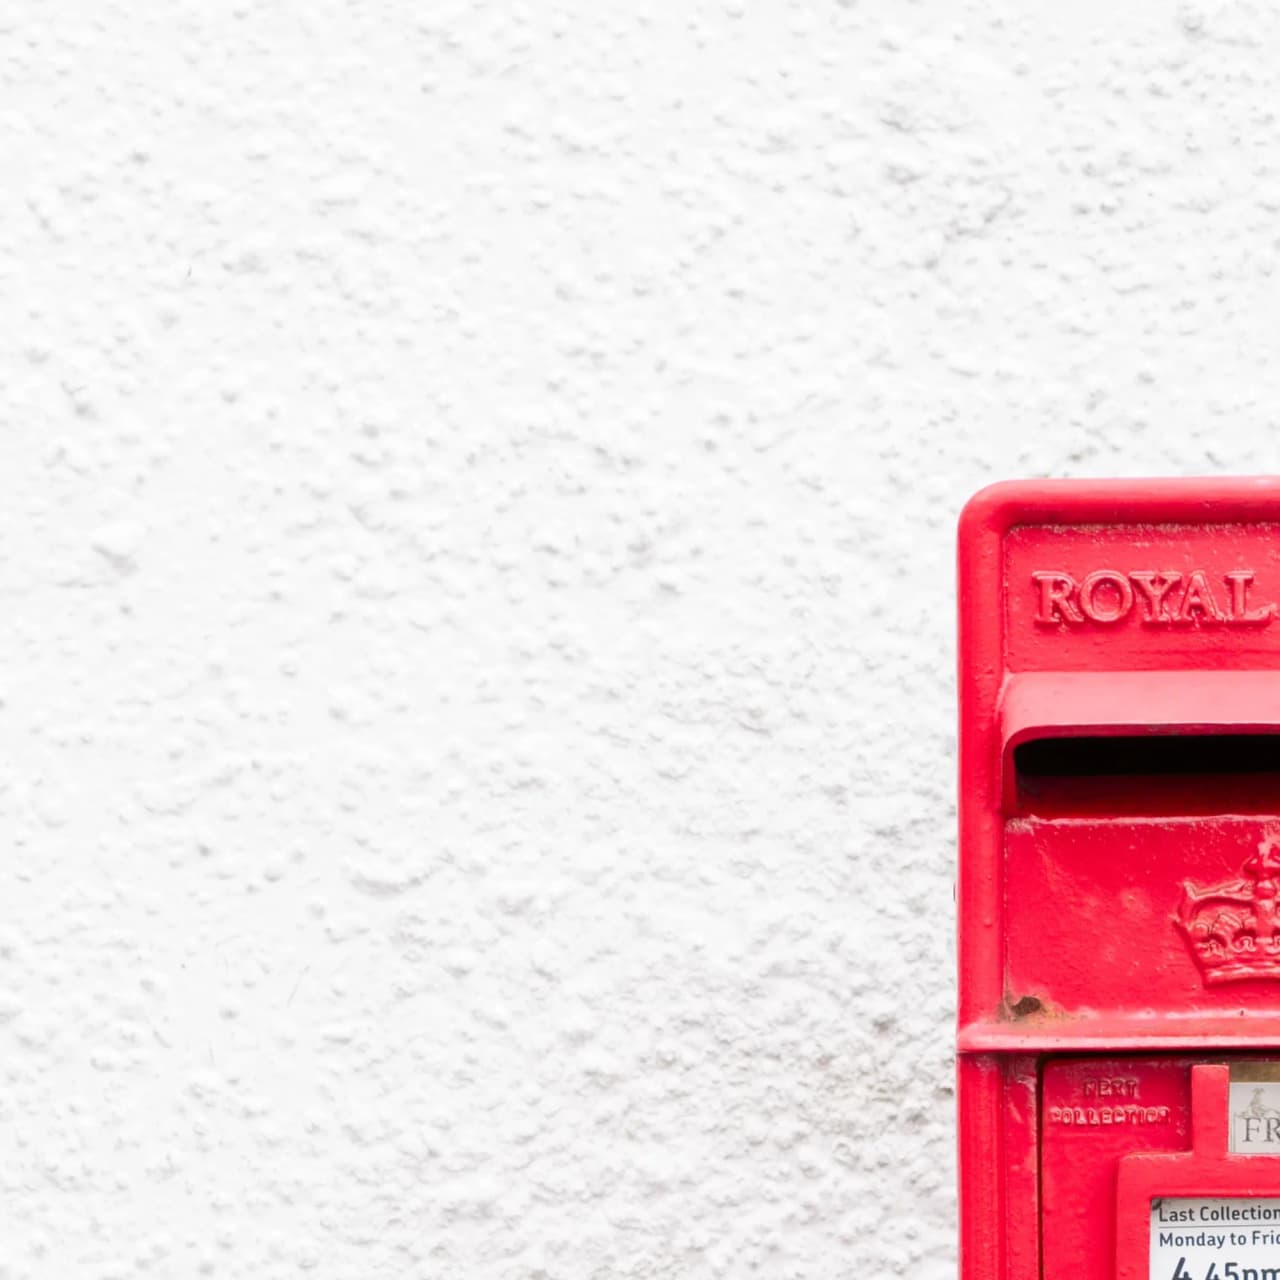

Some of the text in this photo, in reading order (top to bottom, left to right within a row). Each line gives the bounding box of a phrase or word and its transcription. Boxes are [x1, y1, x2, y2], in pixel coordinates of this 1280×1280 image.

[1032, 570, 1273, 628] ROYAL
[1159, 1206, 1195, 1222] Last
[1160, 1232, 1225, 1249] Monday
[1230, 1233, 1246, 1245] to
